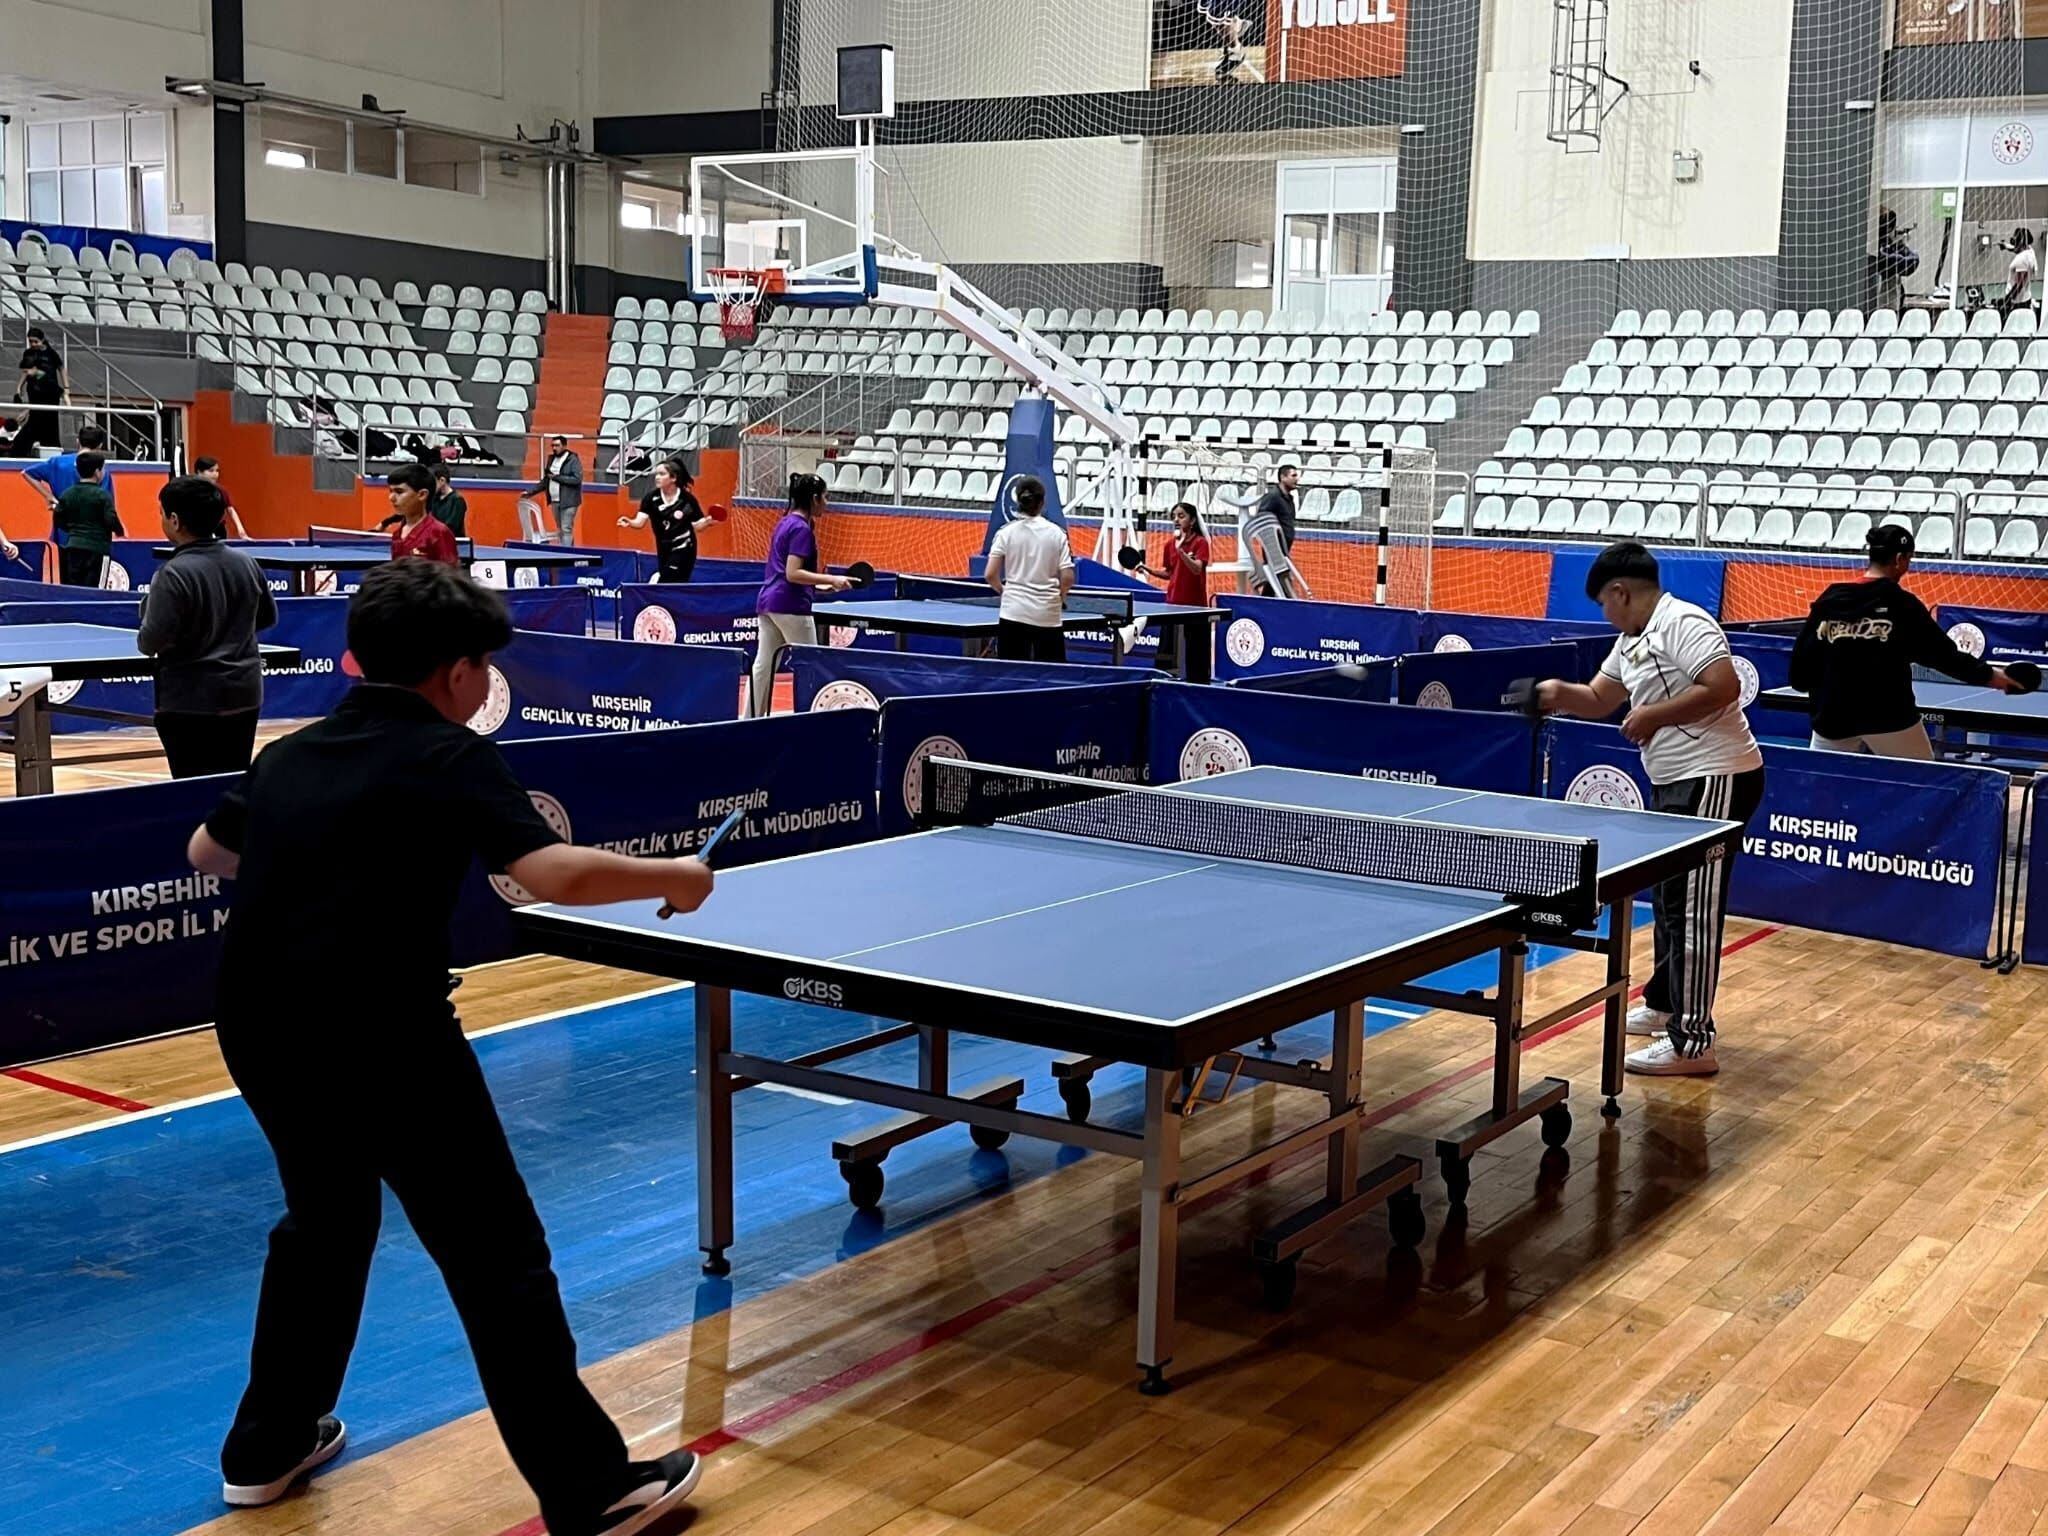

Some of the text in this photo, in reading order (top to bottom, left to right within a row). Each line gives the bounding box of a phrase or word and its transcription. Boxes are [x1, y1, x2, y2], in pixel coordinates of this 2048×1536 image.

[485, 567, 493, 579] 8
[733, 617, 760, 628] KIRŞE
[683, 631, 757, 644] GENÇLİK VE SPOR
[1320, 638, 1360, 651] KIRŞEHİR
[1271, 647, 1308, 660] GENÇLİK
[1308, 650, 1321, 661] VE
[1321, 651, 1345, 664] SPOR
[8, 682, 22, 702] 5
[591, 694, 652, 714] KIRŞEHİR
[521, 706, 575, 725] GENÇLİK
[576, 712, 594, 728] VE
[595, 715, 629, 731] SPOR
[631, 715, 645, 732] İL
[697, 788, 768, 819] KIRŞEHİR
[672, 828, 694, 849] VE
[745, 816, 761, 839] İL
[764, 800, 862, 836] MÜDÜRLÜĞÜ
[1769, 813, 1858, 843] KIRŞEHİR
[1742, 836, 1975, 887] VE SPOR İL MÜDÜRLÜĞÜ
[91, 870, 221, 916] KIRŞEHİR
[1540, 912, 1563, 923] KBS
[49, 930, 89, 959] VE
[95, 917, 175, 951] SPOR
[182, 909, 207, 938] İL
[800, 977, 843, 1001] KBS
